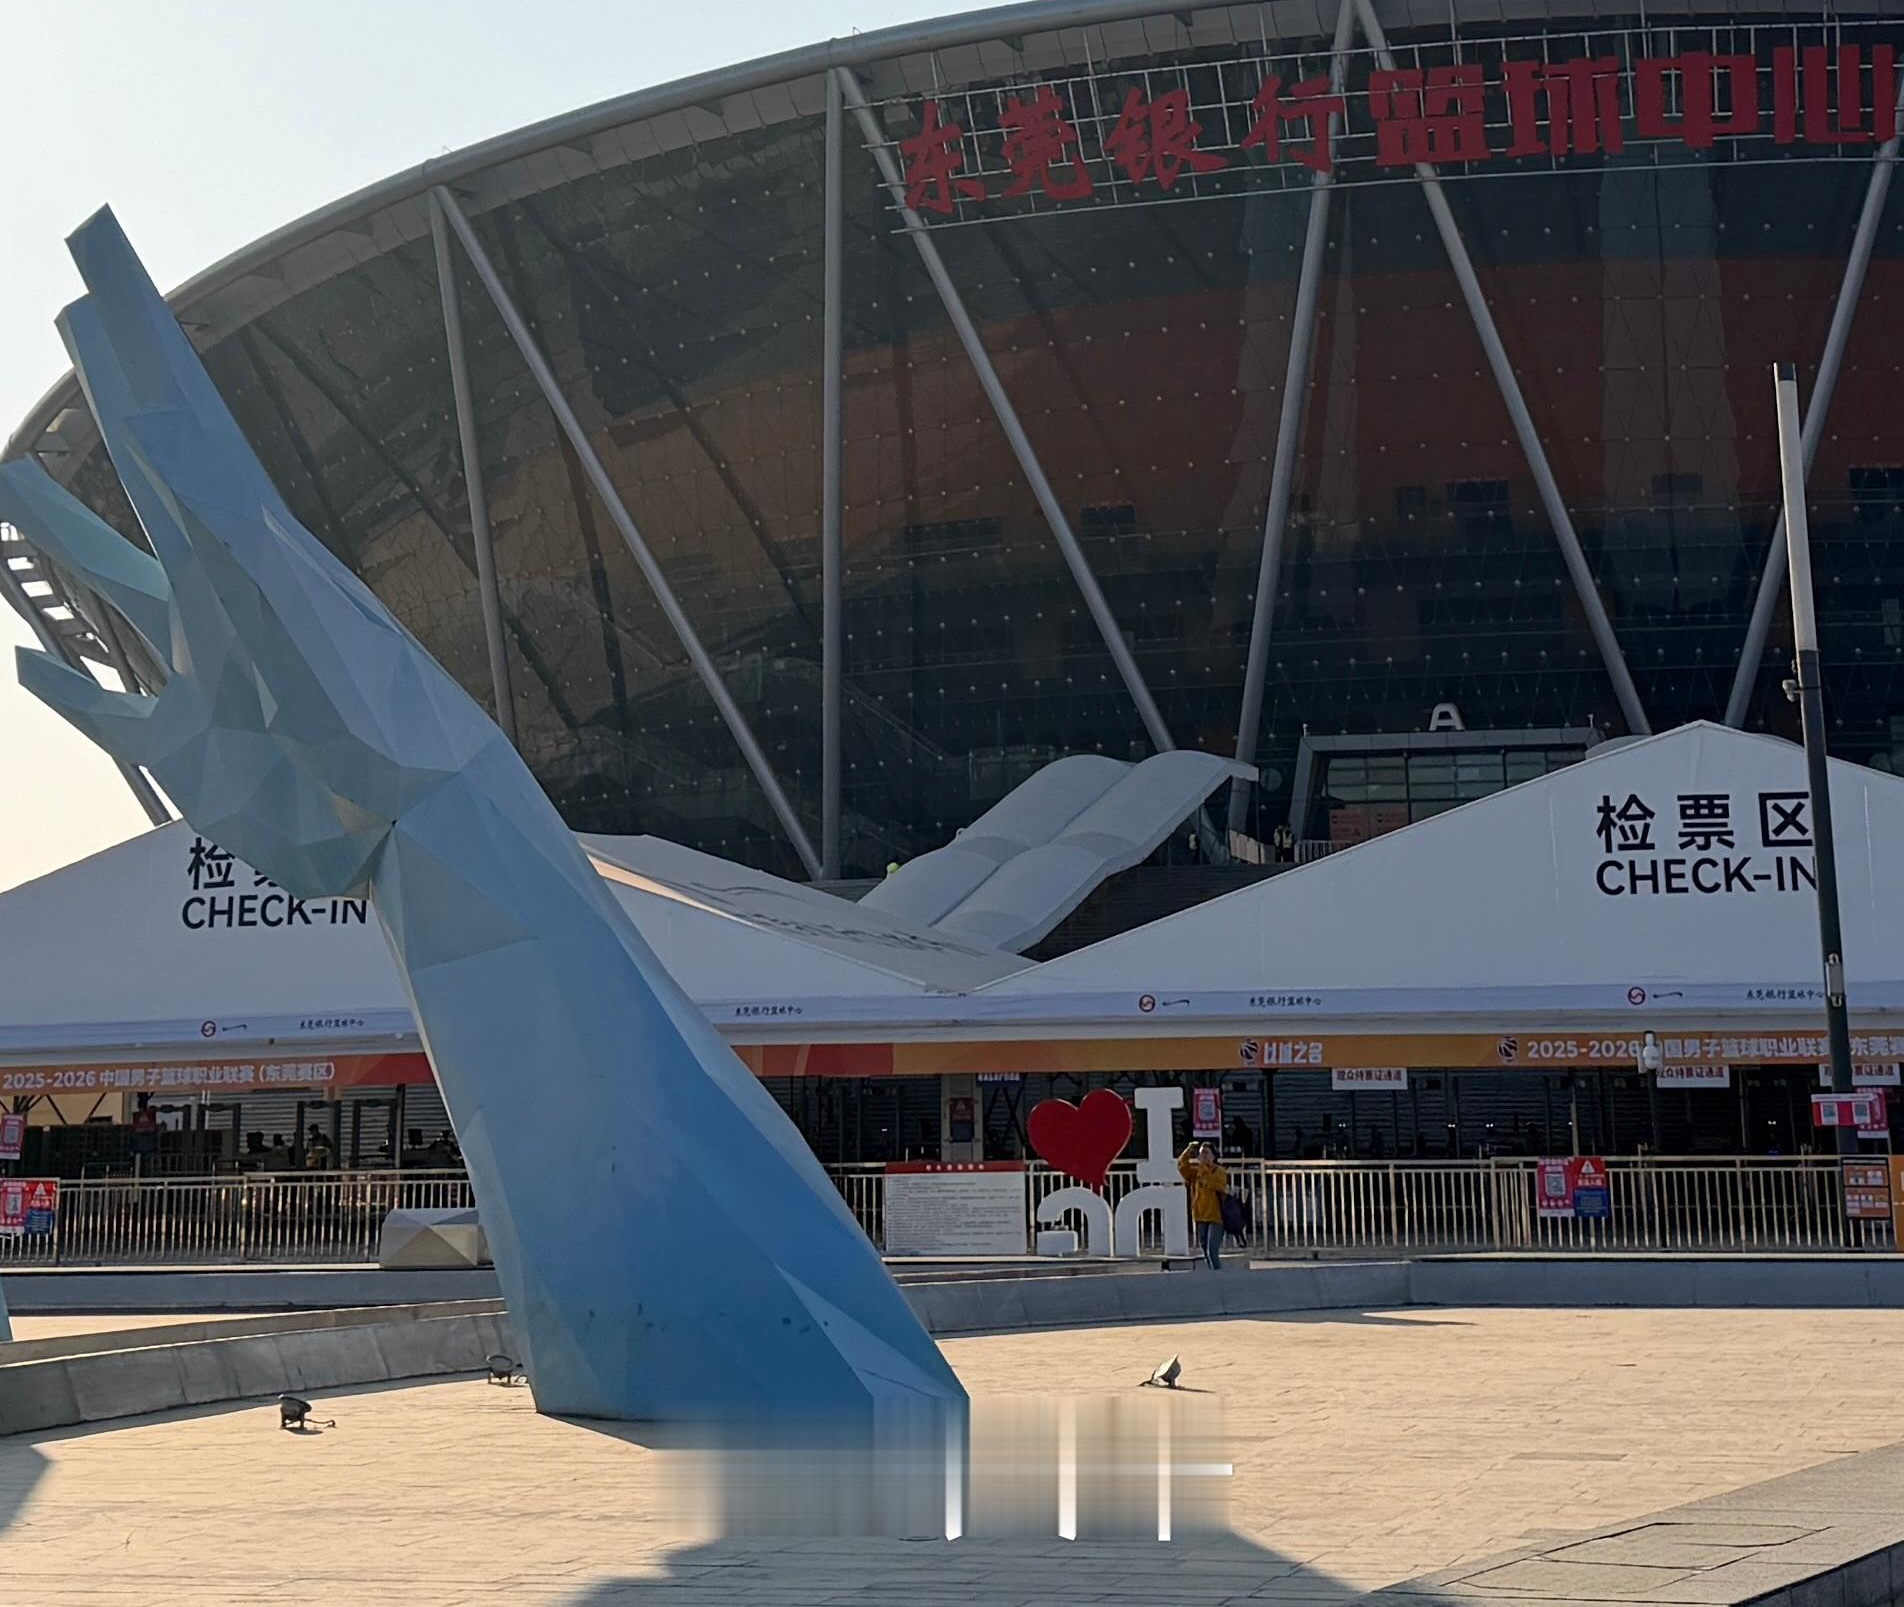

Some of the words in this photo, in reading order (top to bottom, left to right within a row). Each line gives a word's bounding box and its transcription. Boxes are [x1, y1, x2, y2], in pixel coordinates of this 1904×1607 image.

[898, 42, 1897, 213] 东莞银行篮球中心
[1429, 702, 1465, 731] A
[1596, 791, 1813, 853] 检票区
[1596, 855, 1816, 896] CHECK-IN
[182, 893, 368, 929] CHECK-IN
[3, 1069, 96, 1090] 2025-2026
